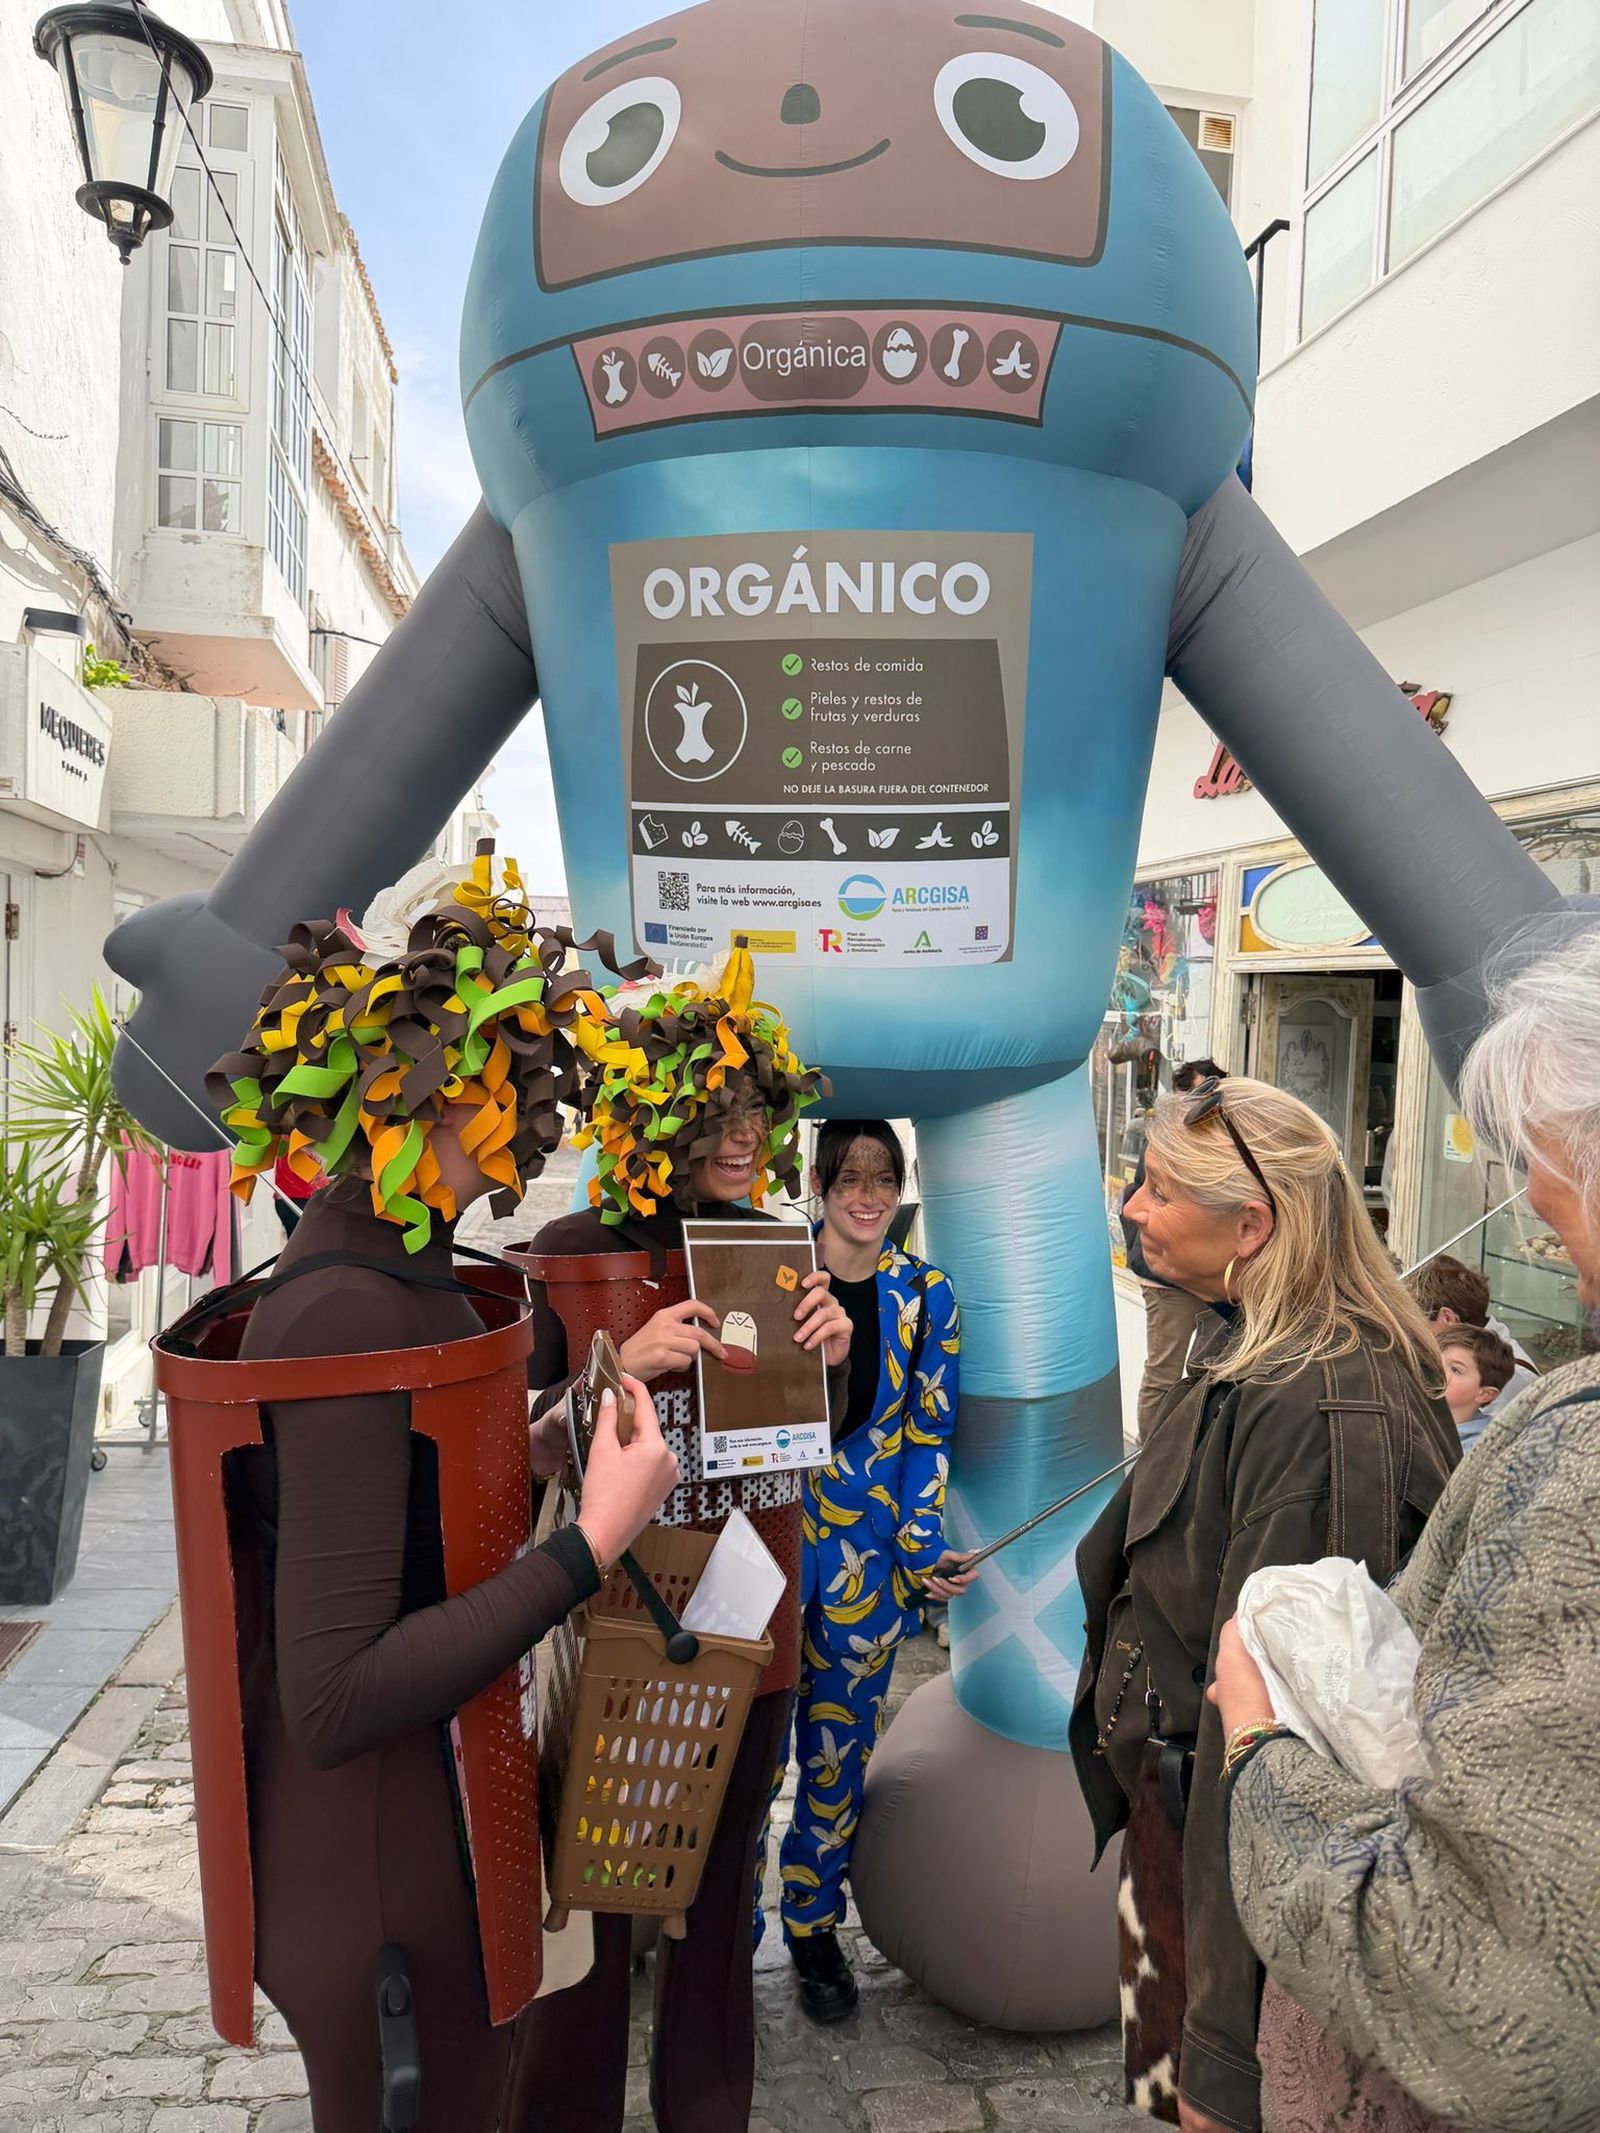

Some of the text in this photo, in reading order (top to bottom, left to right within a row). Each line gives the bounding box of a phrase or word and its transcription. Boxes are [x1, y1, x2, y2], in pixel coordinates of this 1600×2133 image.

[743, 339, 866, 376] Orgánica
[643, 544, 990, 620] ORGÁNICO
[811, 656, 924, 671] Restos de comida
[810, 690, 922, 709] Pieles y restos de
[810, 707, 920, 726] frutas y verduras
[810, 739, 912, 754] Restos de carne
[810, 757, 876, 774] y pescado
[783, 783, 989, 794] NO DEJE LA BASURA FUERA DEL CONTENEDOR
[696, 883, 796, 896] Para más información,
[892, 885, 970, 905] ARCGISA
[697, 895, 822, 909] visite la web www.arcgisaes
